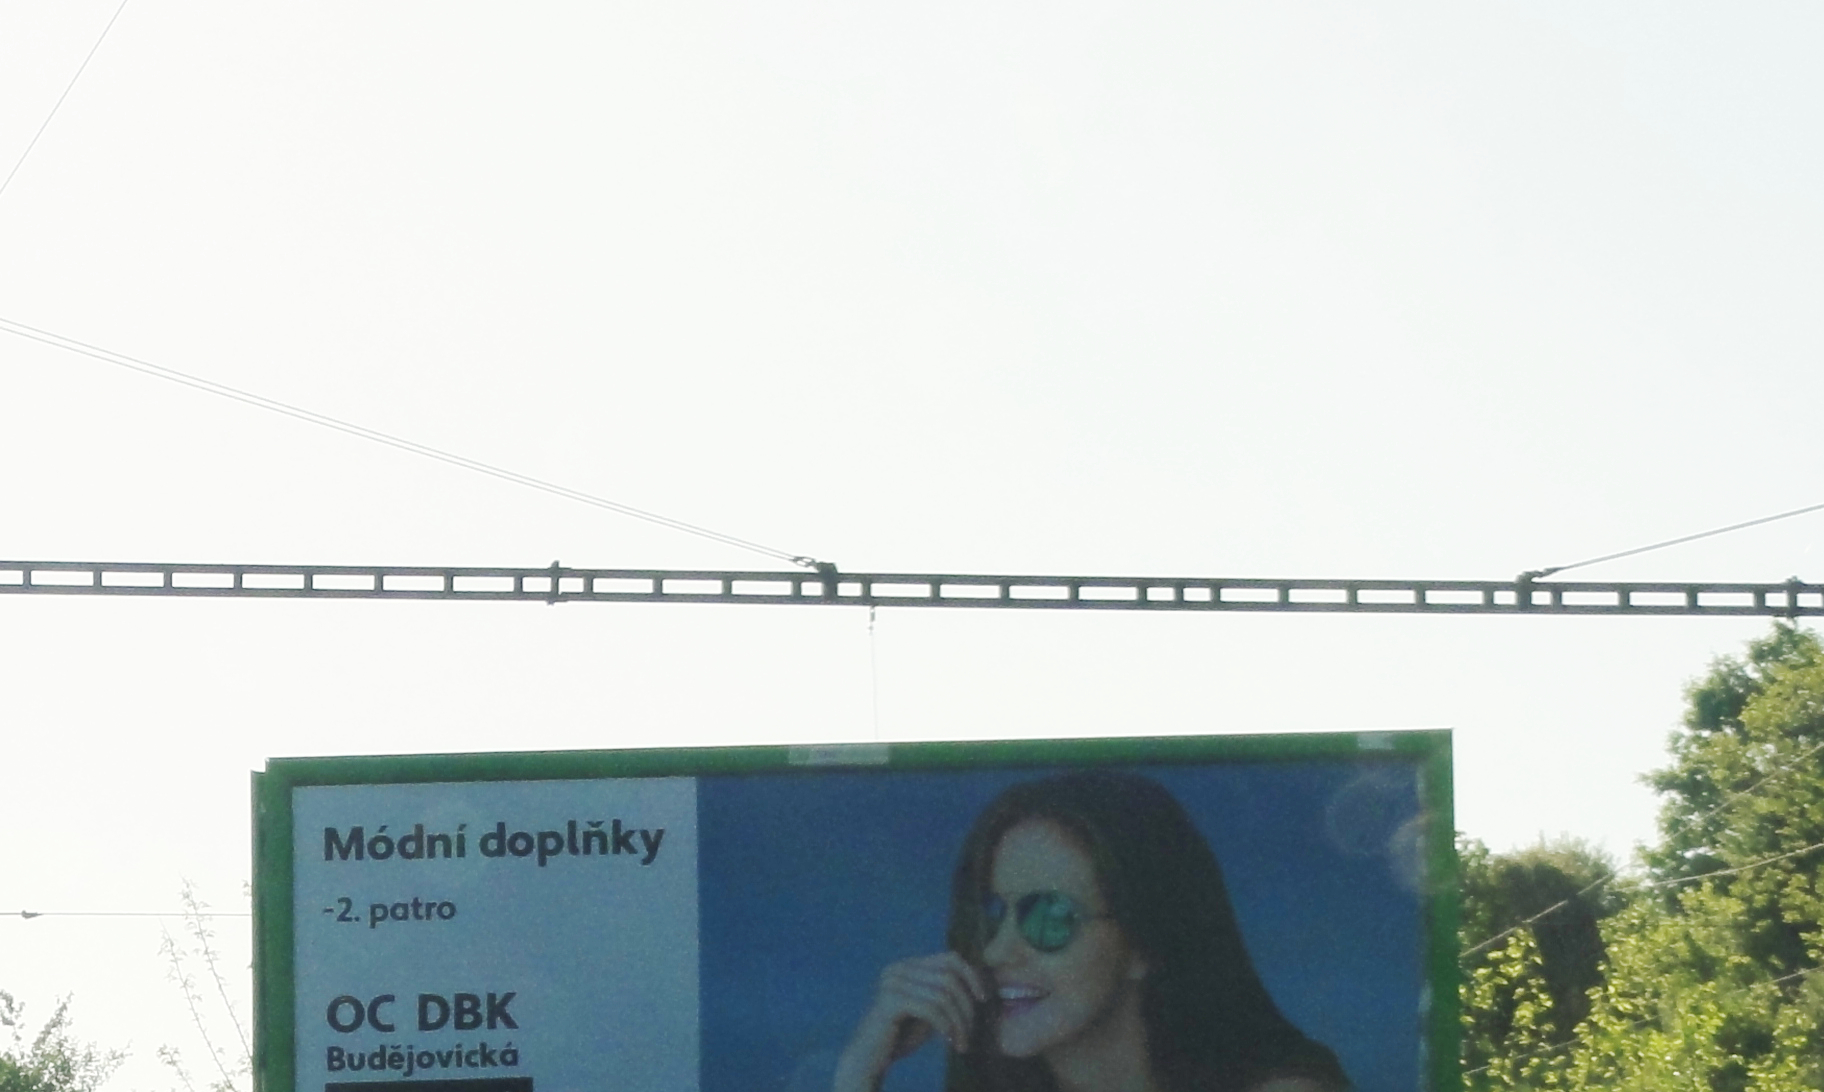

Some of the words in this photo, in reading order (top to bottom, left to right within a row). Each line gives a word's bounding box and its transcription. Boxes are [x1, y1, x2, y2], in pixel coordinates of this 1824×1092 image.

[324, 823, 468, 861] Módní
[479, 818, 666, 867] doplňky
[369, 897, 458, 929] patro
[327, 994, 396, 1034] OC
[418, 992, 519, 1031] DBK
[327, 1042, 519, 1077] Budějovická
